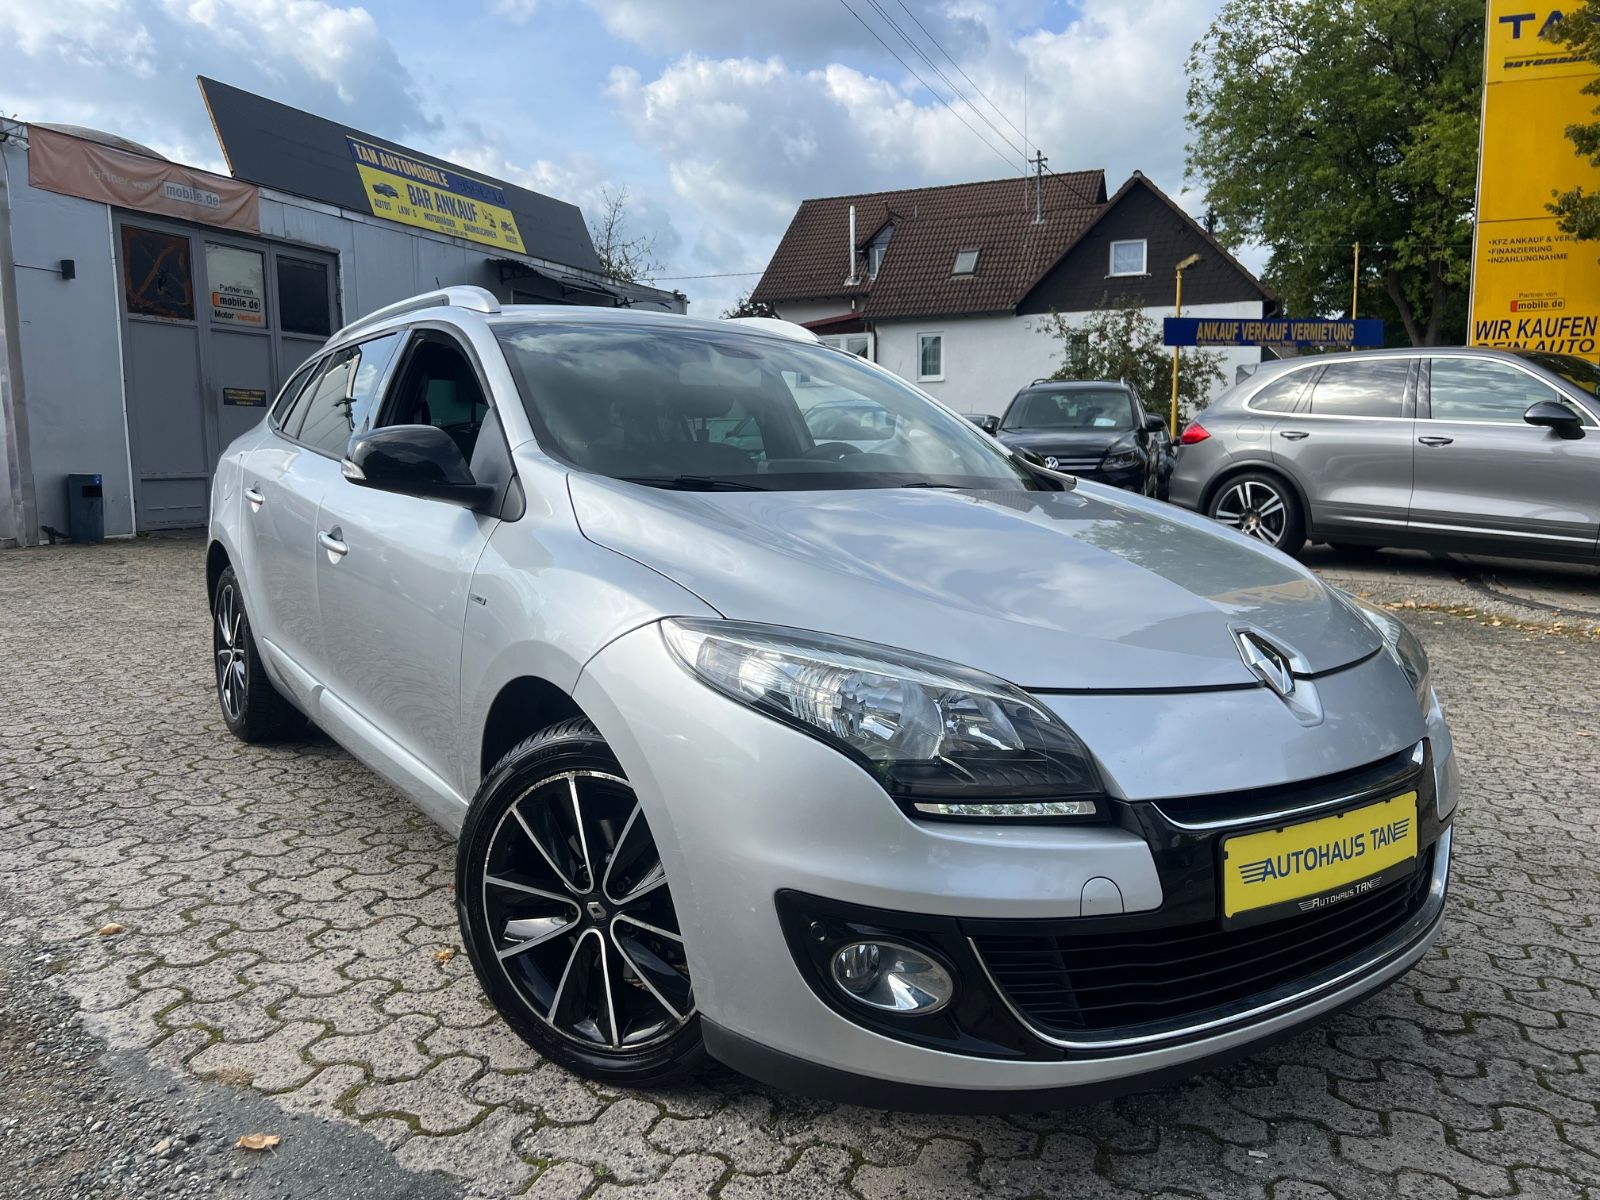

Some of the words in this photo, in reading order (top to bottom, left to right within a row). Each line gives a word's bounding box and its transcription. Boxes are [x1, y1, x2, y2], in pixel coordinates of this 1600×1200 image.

[353, 143, 379, 165] TAN
[379, 152, 449, 188] AUTOMOBILE
[165, 184, 219, 207] mobile.de
[406, 183, 433, 211] BAR
[434, 191, 478, 224] ANKAUF
[1510, 236, 1543, 245] ANKAUF
[1491, 246, 1552, 255] FINANZIERUNG
[219, 296, 259, 310] mobile.de
[1518, 300, 1563, 309] mobile.de
[214, 310, 235, 319] Motor
[1196, 322, 1238, 341] ANKAUF
[1242, 322, 1288, 341] VERKAUF
[1290, 322, 1355, 341] VERMIETUNG
[1475, 320, 1512, 341] WIR
[1516, 316, 1598, 339] KAUFEN
[1262, 832, 1366, 882] AUTOHAUS
[1370, 821, 1397, 851] TAN
[1355, 881, 1373, 894] TAN
